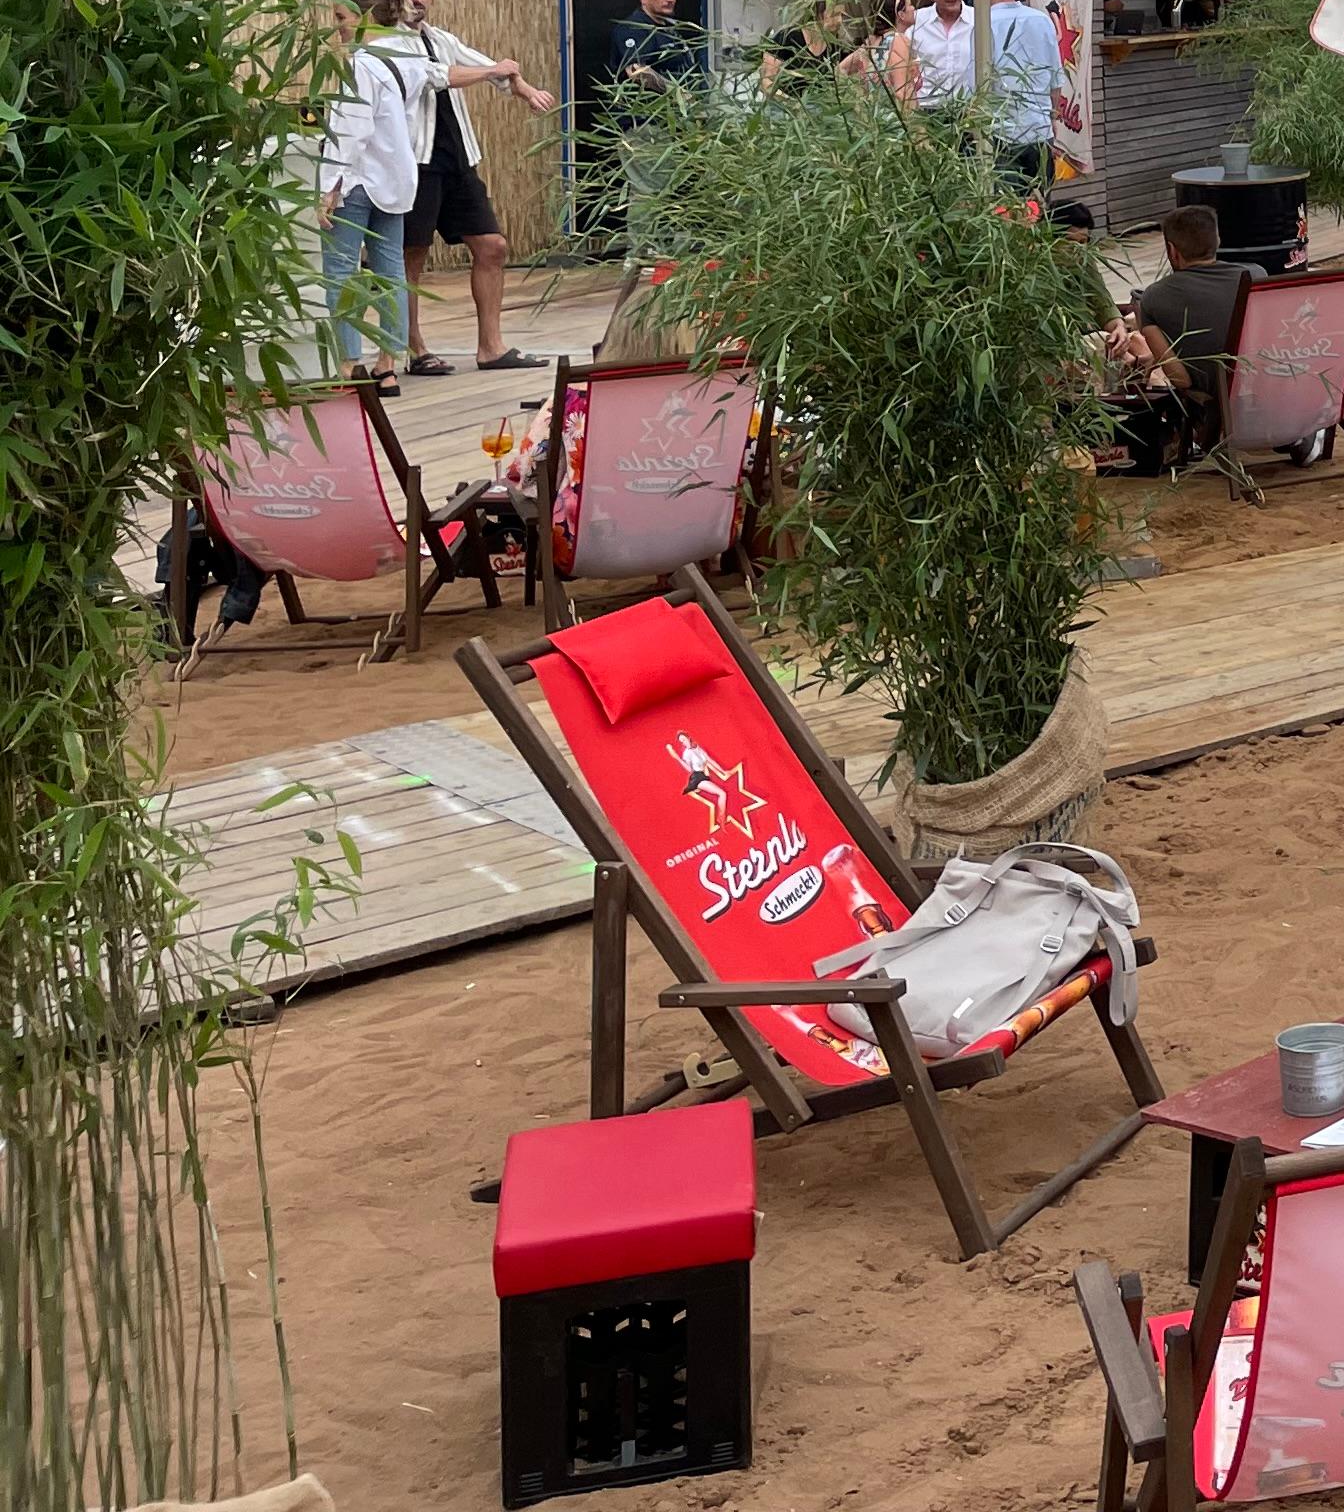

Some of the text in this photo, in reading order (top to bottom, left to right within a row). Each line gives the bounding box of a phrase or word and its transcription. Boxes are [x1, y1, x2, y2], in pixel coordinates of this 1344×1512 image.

[666, 837, 720, 869] ORIGINAL
[698, 812, 808, 923] Sternla
[764, 866, 818, 920] Schmeckt!
